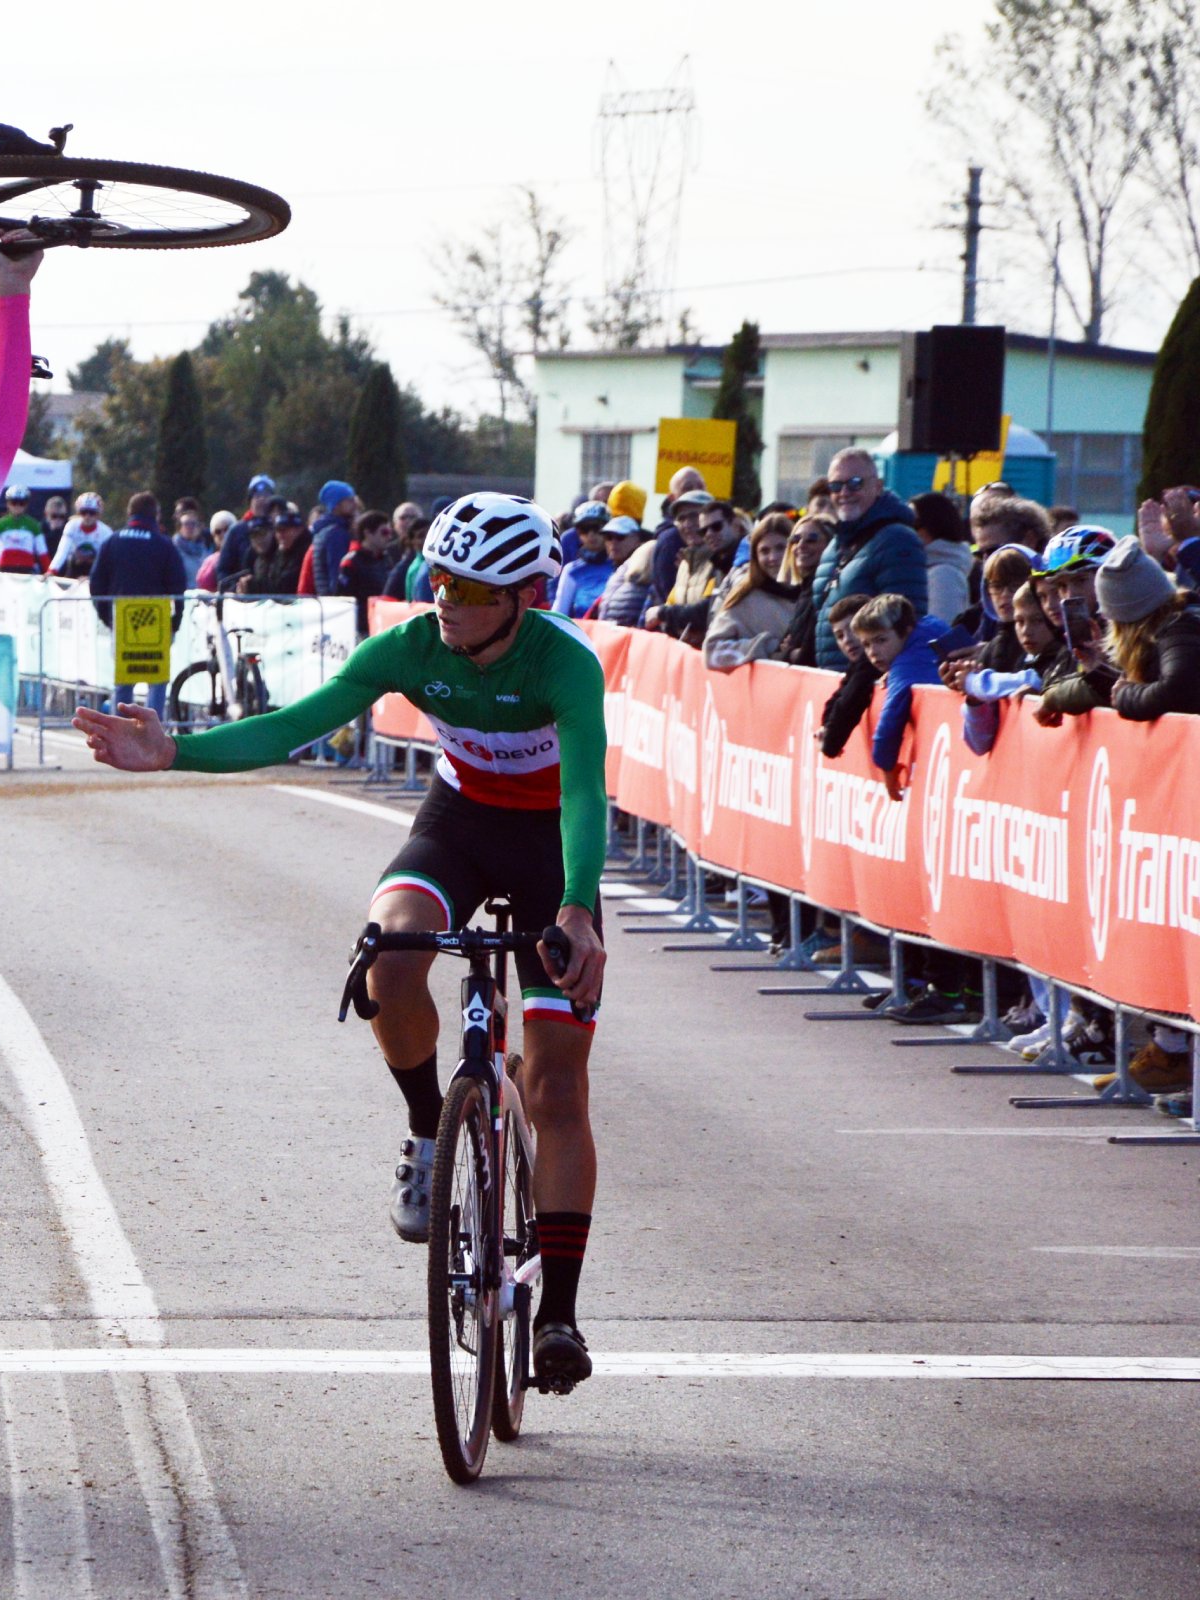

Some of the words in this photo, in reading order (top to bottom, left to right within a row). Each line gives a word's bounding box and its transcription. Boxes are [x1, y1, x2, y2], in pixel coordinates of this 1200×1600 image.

[494, 739, 554, 760] DEVO
[949, 769, 1070, 904] francesconi
[468, 1008, 485, 1022] G
